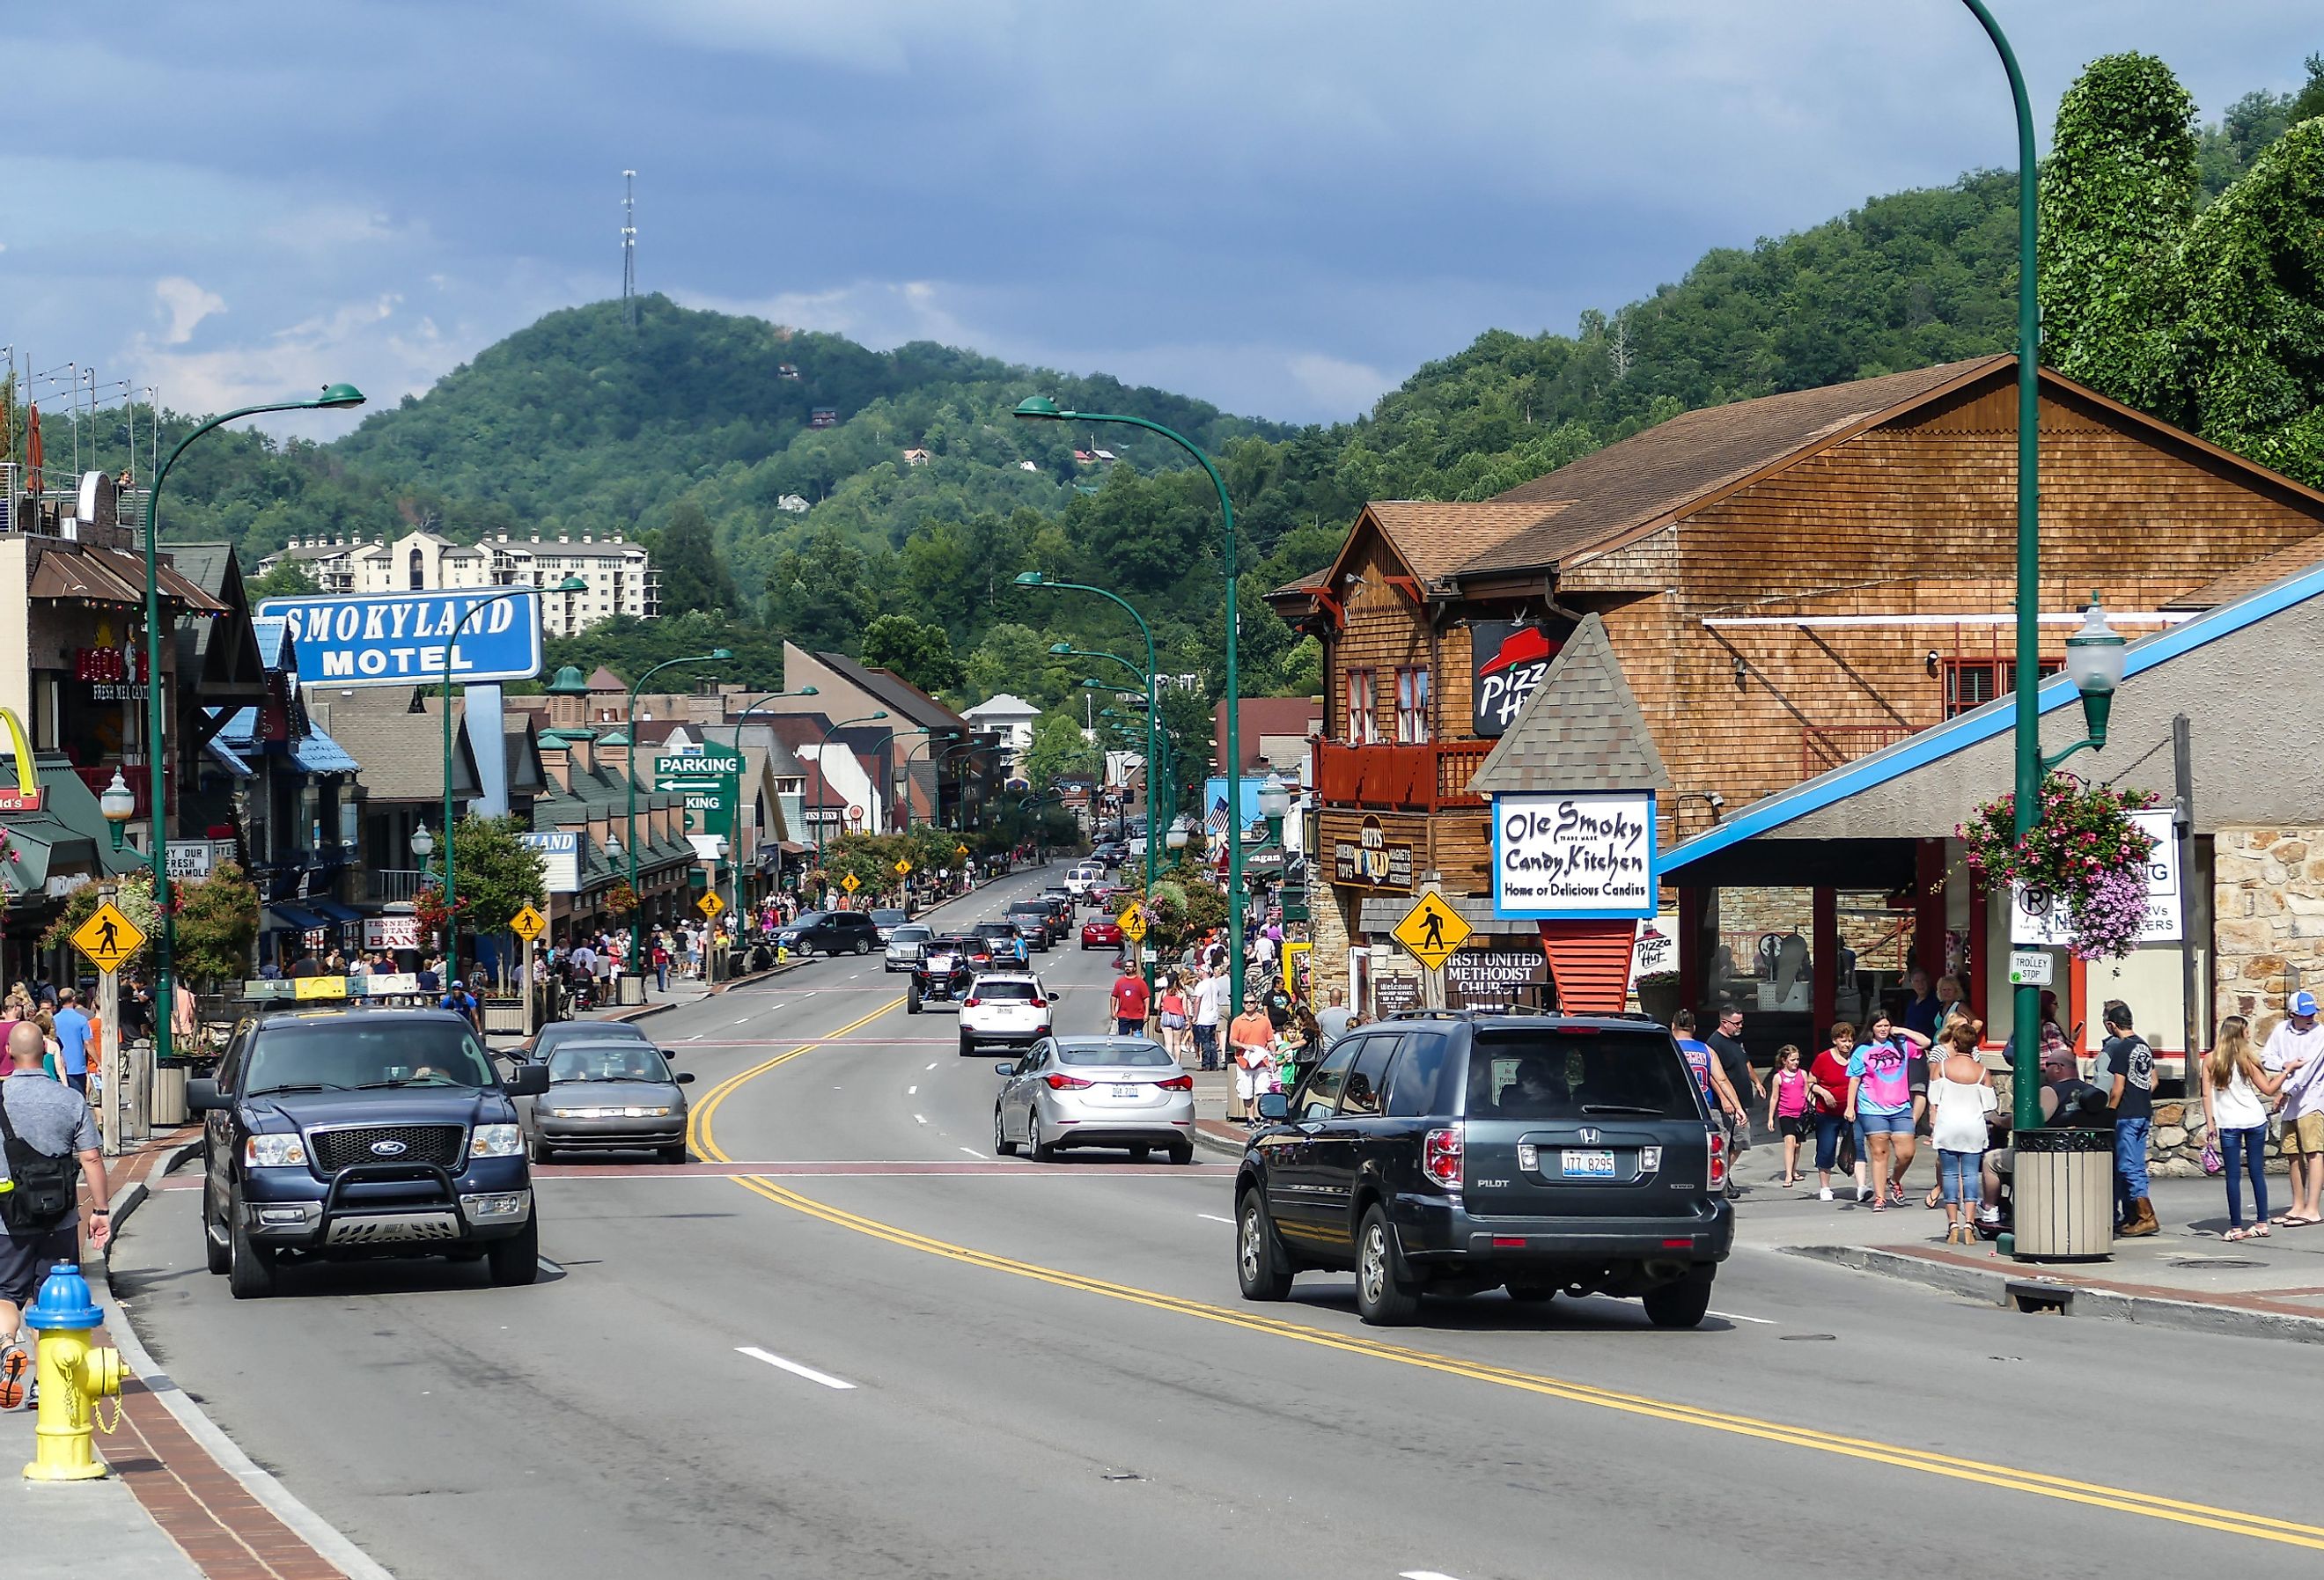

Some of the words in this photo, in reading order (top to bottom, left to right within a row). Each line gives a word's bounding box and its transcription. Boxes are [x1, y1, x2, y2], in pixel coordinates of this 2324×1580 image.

[287, 598, 513, 643] SMOKYLAND
[322, 644, 473, 676] MOTEL
[1481, 658, 1547, 717] Pizz
[659, 758, 737, 772] PARKING
[685, 797, 720, 809] KING
[1506, 812, 1551, 844] Ole
[1554, 800, 1643, 852] Smoky
[1361, 827, 1383, 849] GIFTS
[185, 849, 202, 857] OUR
[1248, 854, 1281, 863] eagan
[1506, 849, 1563, 884] Candy
[1563, 842, 1643, 882] Kitchen
[166, 869, 210, 878] ACAMOLE
[1337, 863, 1353, 879] TOYS
[1504, 882, 1533, 896] Home
[1550, 882, 1599, 896] Delicious
[1602, 882, 1645, 896] Candies
[369, 936, 416, 946] BAN
[1636, 939, 1672, 958] Pizza
[1447, 953, 1481, 966] IRST
[1485, 953, 1542, 966] UNITED
[1641, 952, 1666, 966] Hut
[2016, 958, 2048, 968] TROLLEY
[1448, 967, 1533, 981] METHODIST
[378, 1143, 399, 1153] Ford
[1564, 1157, 1581, 1171] J77
[1588, 1157, 1612, 1172] 8295
